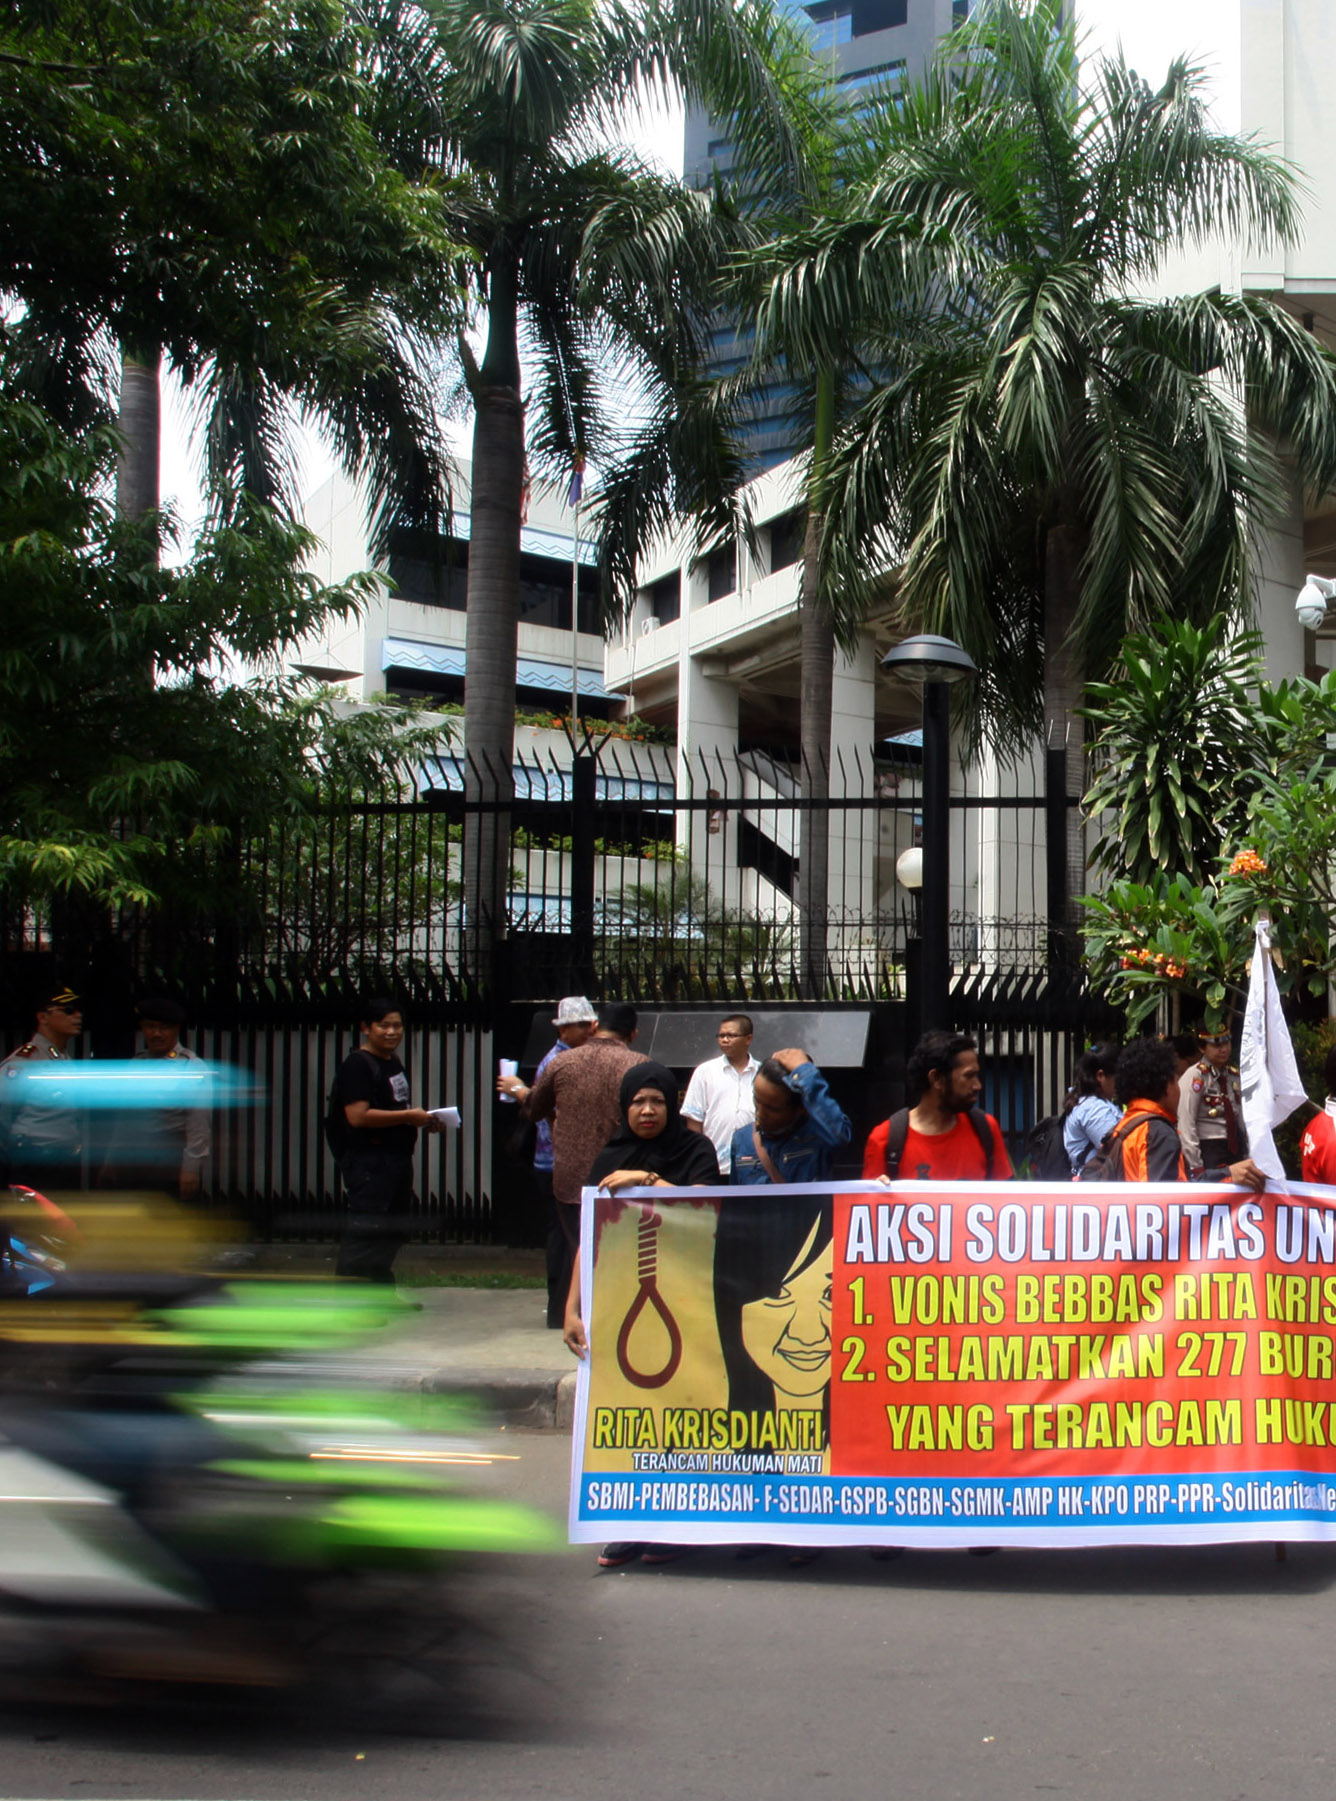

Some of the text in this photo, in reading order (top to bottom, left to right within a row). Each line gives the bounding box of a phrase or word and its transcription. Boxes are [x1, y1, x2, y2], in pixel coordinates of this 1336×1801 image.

[845, 1203, 952, 1264] AKSI
[964, 1202, 1265, 1263] SOLIDARITAS
[848, 1274, 874, 1326] 1.
[889, 1274, 1006, 1326] VONIS
[1014, 1273, 1164, 1324] BEBBAS
[1173, 1271, 1258, 1321] RITA
[840, 1334, 877, 1383] 2.
[885, 1332, 1165, 1383] SELAMATKAN
[1176, 1330, 1248, 1379] 277
[593, 1408, 824, 1452] RITA KRISDIANTI
[886, 1403, 995, 1451] YANG
[1005, 1398, 1244, 1450] TERANCAM
[632, 1452, 823, 1473] TERANCAM HUKUMAN MATI
[1057, 1485, 1129, 1516] HK-KPO
